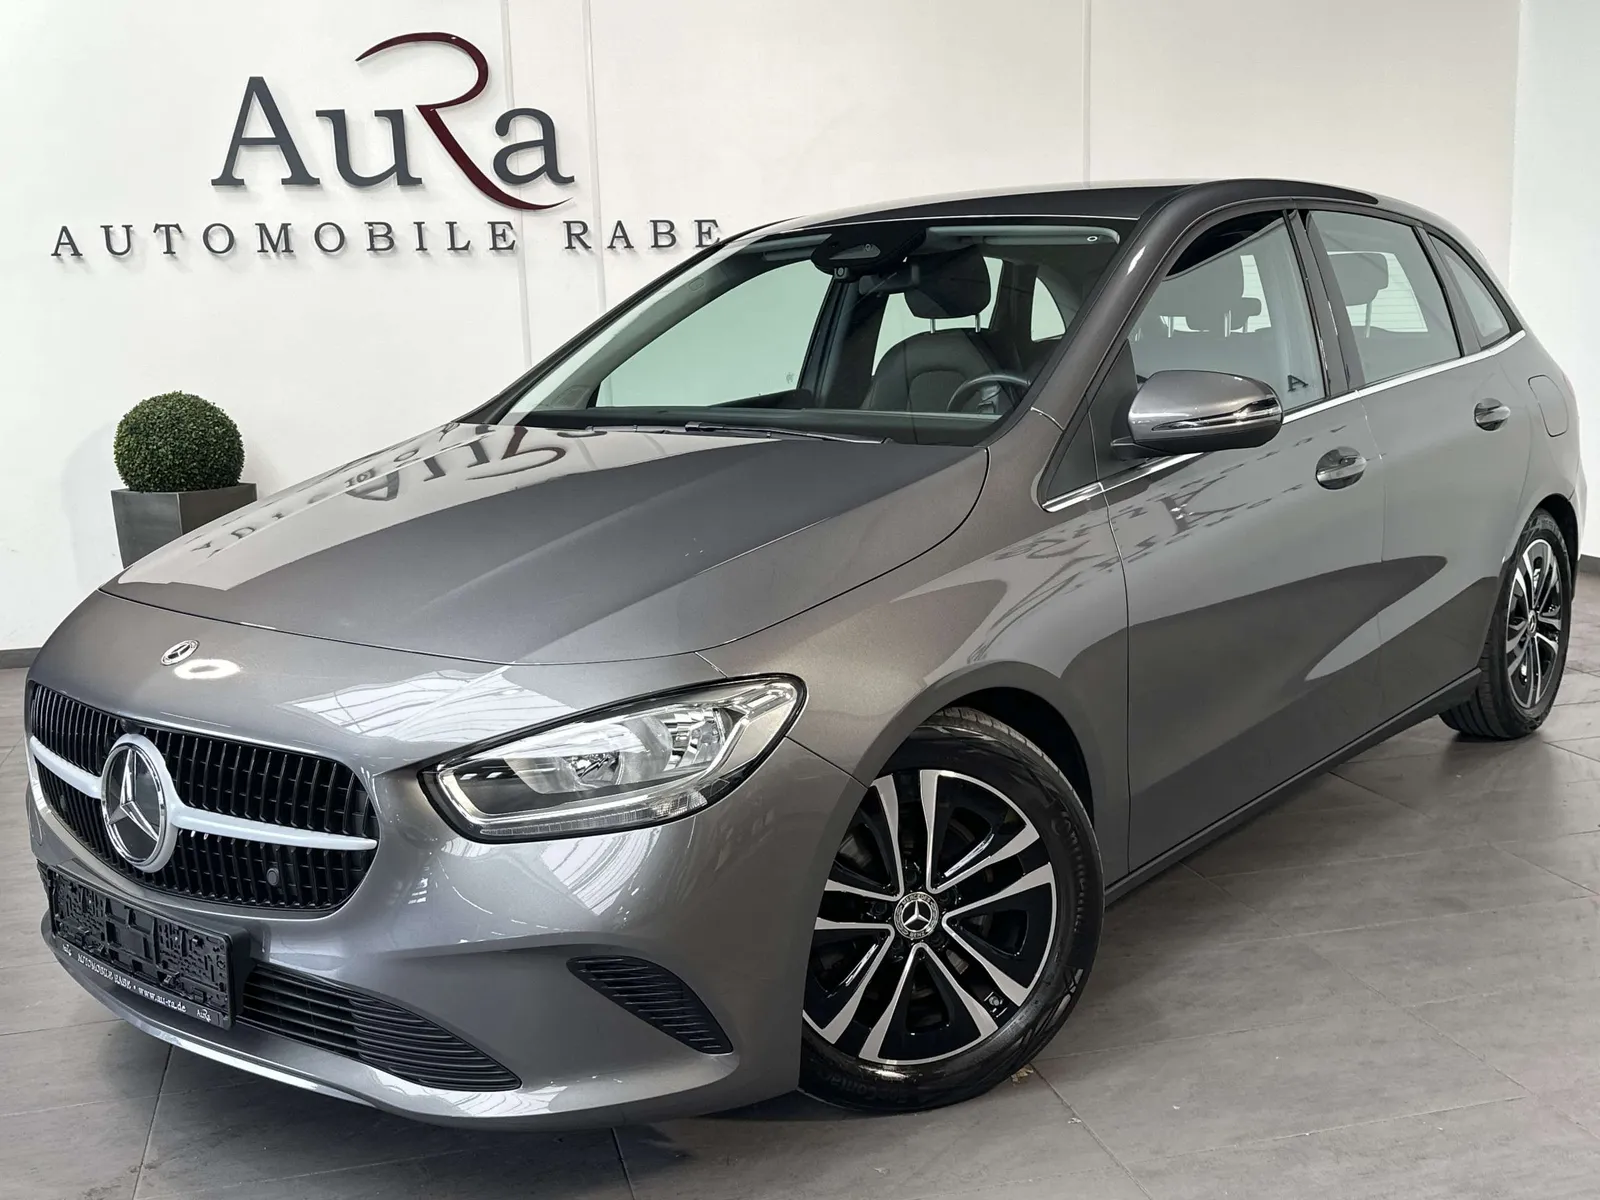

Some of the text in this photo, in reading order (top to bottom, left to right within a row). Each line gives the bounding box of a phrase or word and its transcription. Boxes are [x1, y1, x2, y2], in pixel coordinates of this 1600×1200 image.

[210, 32, 574, 211] AuRa
[51, 218, 723, 258] AUTOMOBILE RABE
